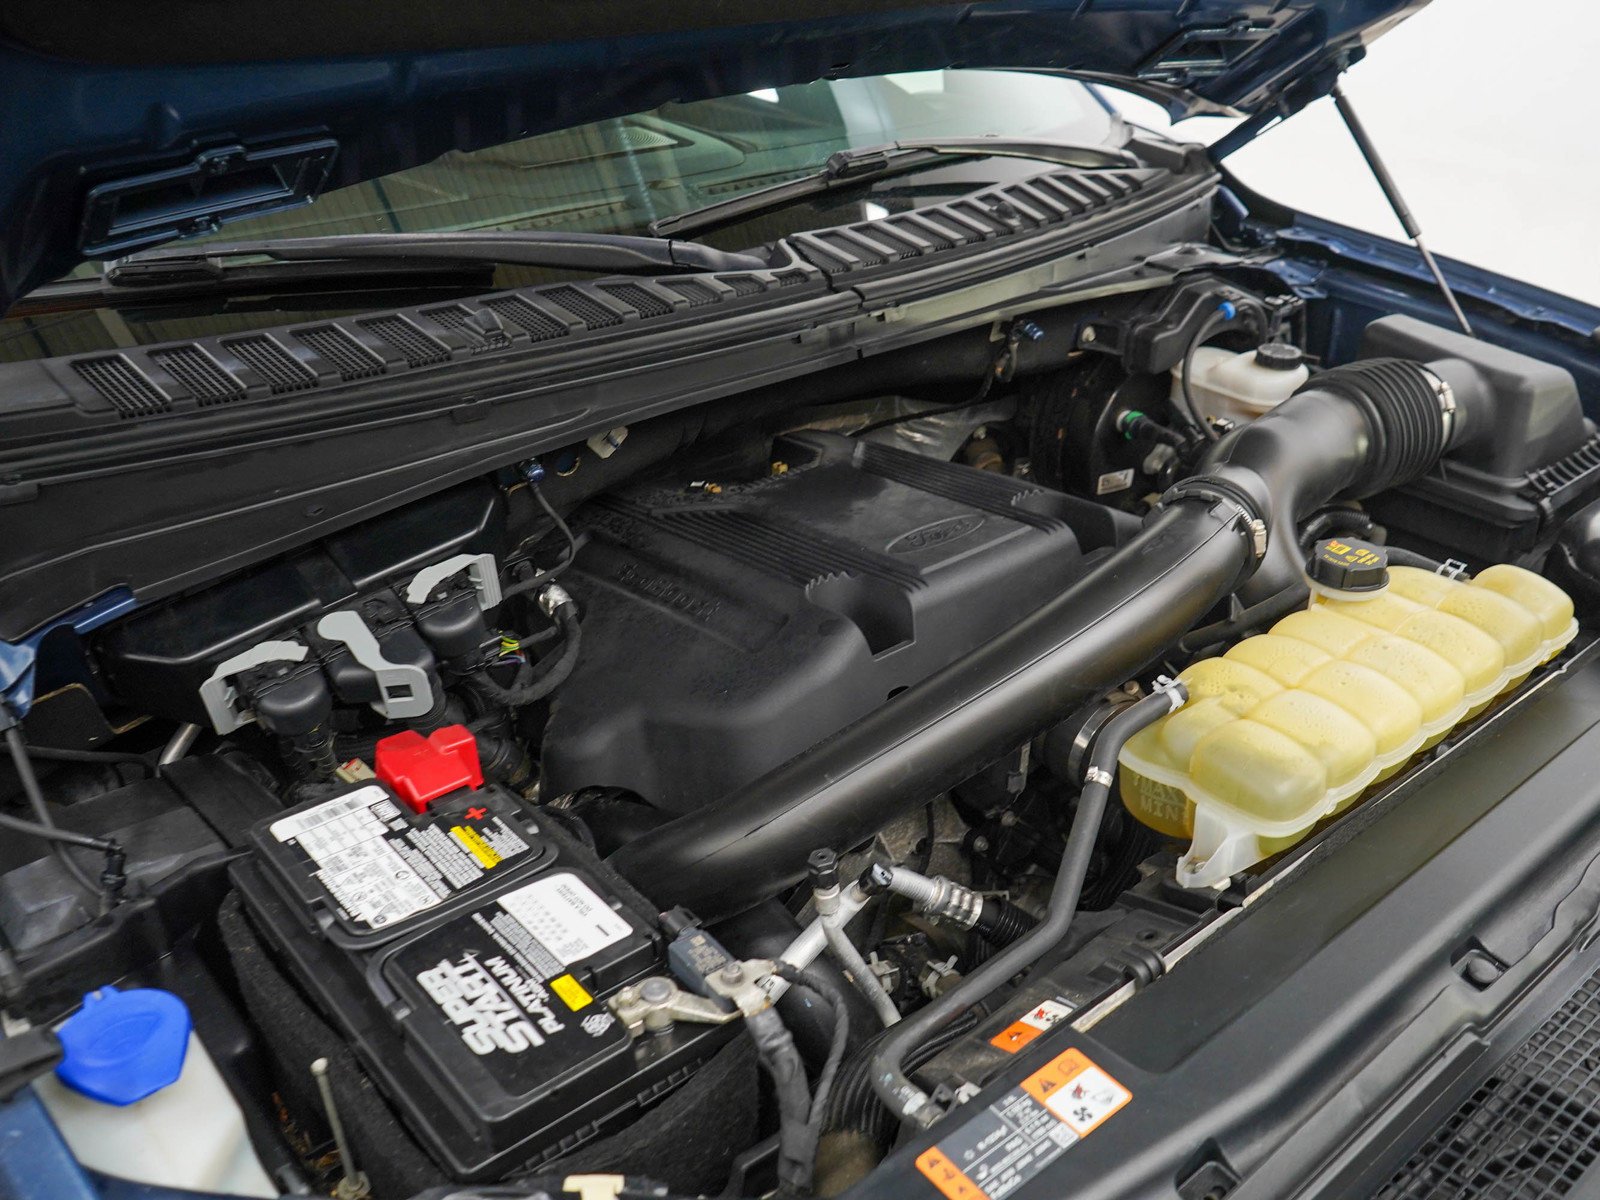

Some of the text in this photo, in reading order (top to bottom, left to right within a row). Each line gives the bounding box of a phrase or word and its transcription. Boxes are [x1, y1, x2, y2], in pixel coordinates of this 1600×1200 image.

[1140, 779, 1179, 800] MAX
[1140, 795, 1179, 822] MIN
[416, 962, 498, 1055] SUPER
[440, 957, 545, 1054] START
[484, 956, 565, 1034] PLATINUM
